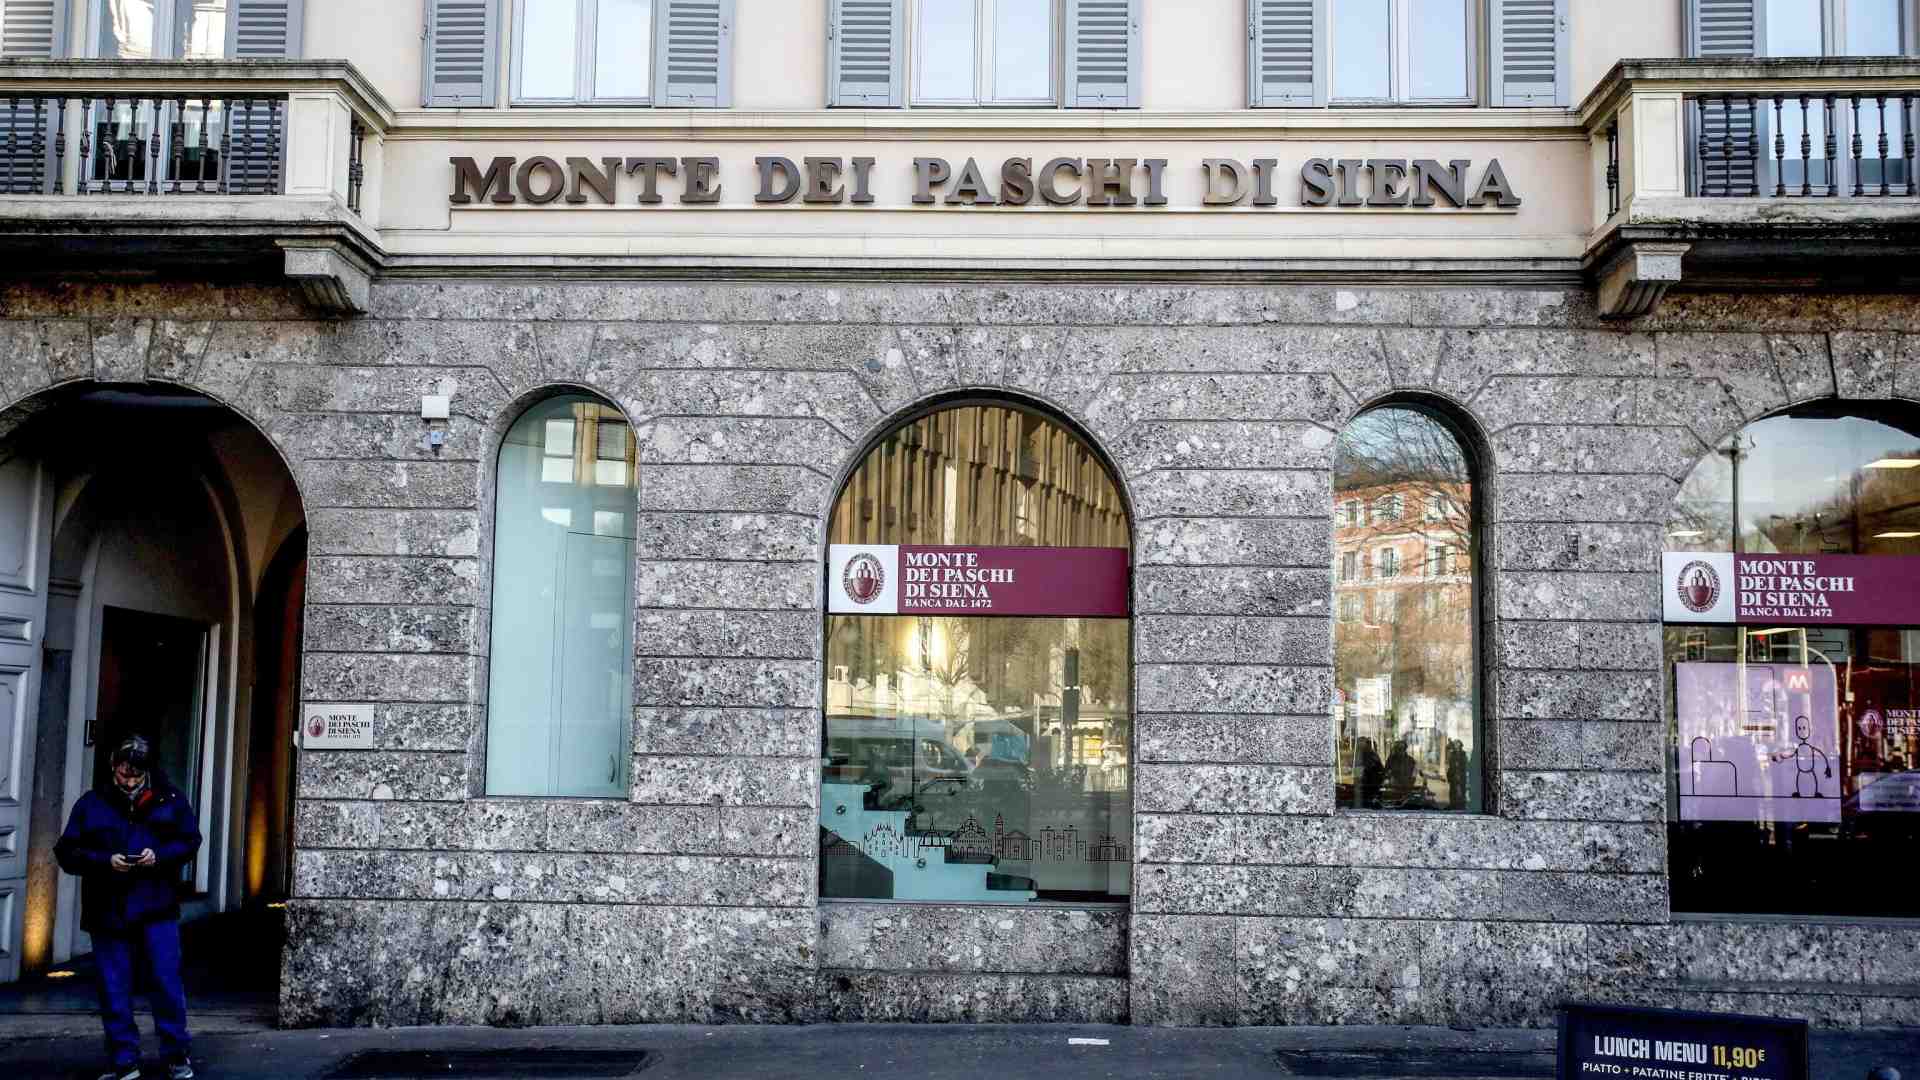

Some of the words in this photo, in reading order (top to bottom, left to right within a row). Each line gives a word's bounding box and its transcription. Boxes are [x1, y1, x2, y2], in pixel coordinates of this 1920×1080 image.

[449, 155, 722, 204] MONTE
[754, 156, 876, 205] DEI
[912, 156, 1168, 206] PASCHI
[1202, 158, 1278, 206] DI
[1300, 157, 1522, 208] SIENA
[906, 553, 978, 567] MONTE
[905, 568, 939, 583] DEI
[943, 568, 1015, 583] PASCHI
[1740, 561, 1816, 575] MONTE
[905, 583, 927, 598] DI
[930, 583, 989, 599] SIENA
[1740, 576, 1775, 591] DEI
[1779, 576, 1856, 592] PASCHI
[905, 599, 942, 608] BANCA
[945, 599, 967, 608] DAL
[970, 599, 993, 608] 1472
[1740, 592, 1763, 606] DI
[1765, 592, 1829, 607] SIENA
[1740, 607, 1780, 617] BANCA
[1783, 608, 1807, 617] DAL
[1809, 608, 1833, 618] 1472
[1594, 1035, 1650, 1059] LUNCH
[1655, 1038, 1708, 1064] MENU
[1712, 1045, 1766, 1070] 11,90€
[1582, 1062, 1621, 1074] PIATTO
[1632, 1066, 1686, 1080] PATATINE
